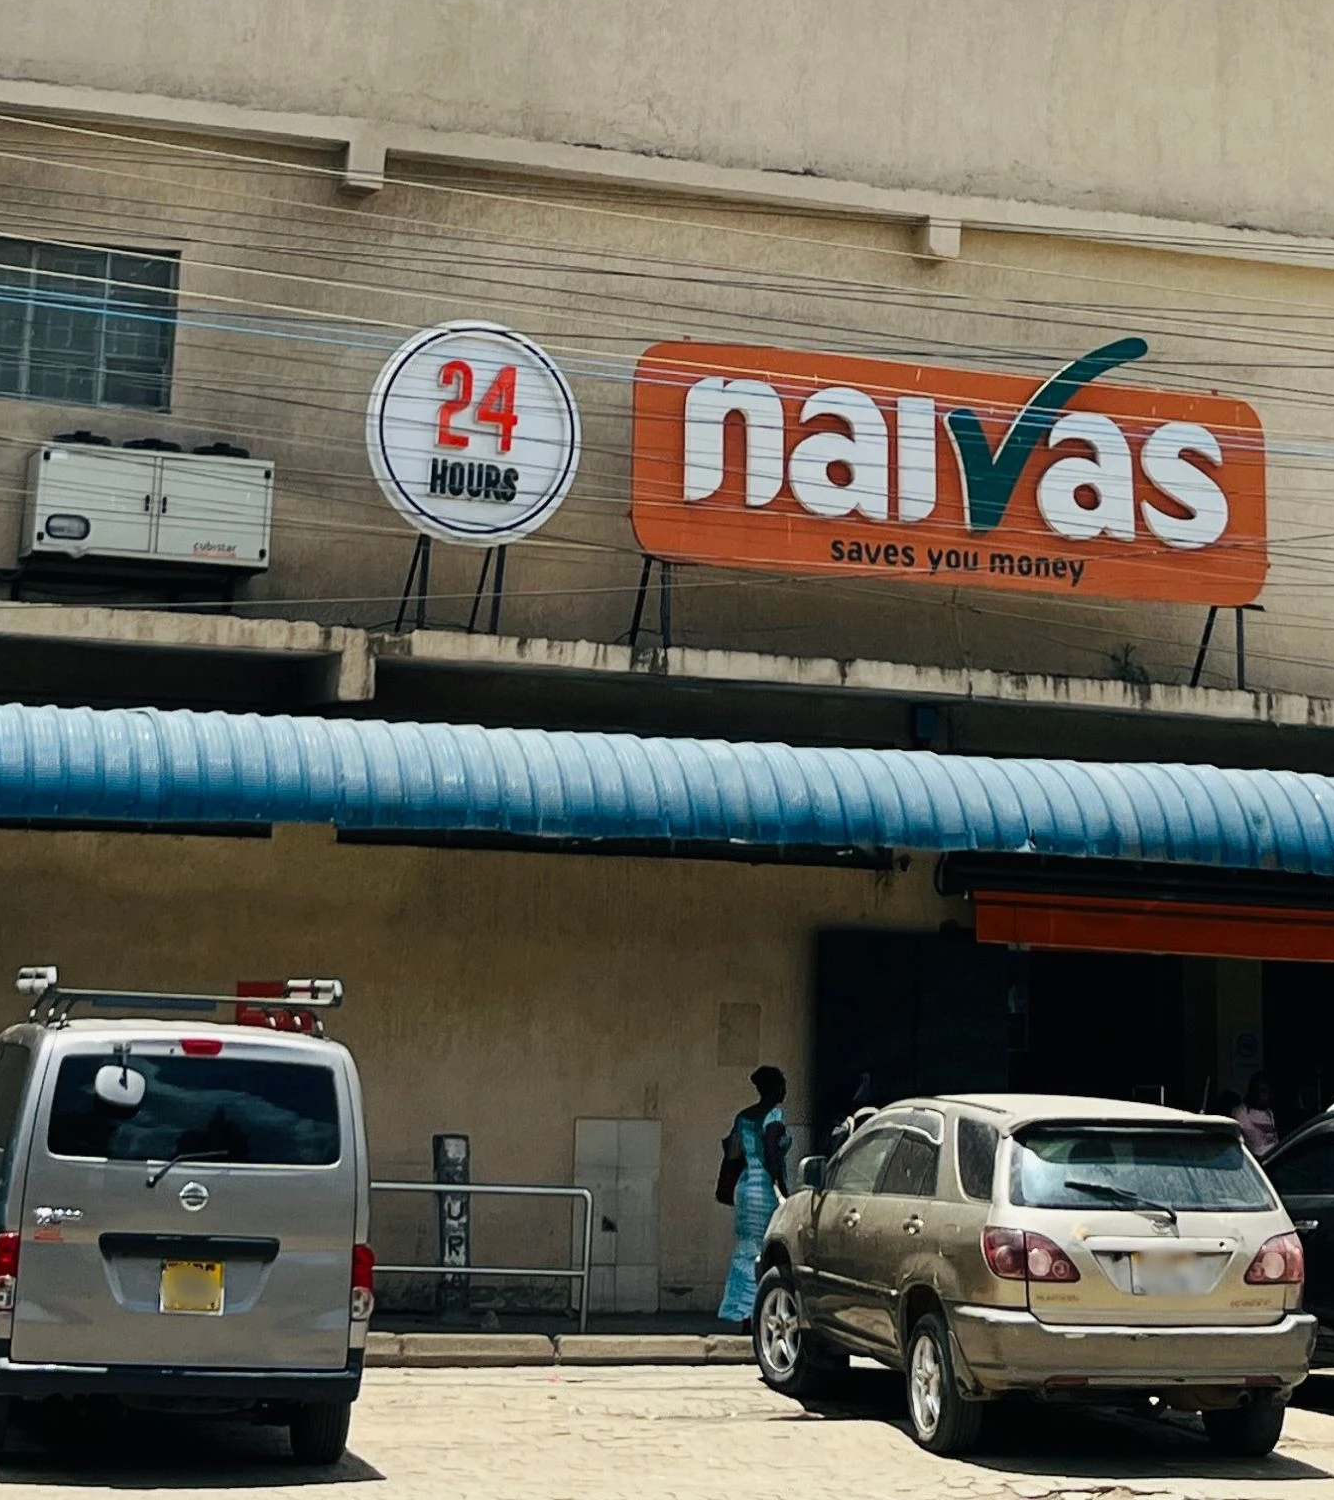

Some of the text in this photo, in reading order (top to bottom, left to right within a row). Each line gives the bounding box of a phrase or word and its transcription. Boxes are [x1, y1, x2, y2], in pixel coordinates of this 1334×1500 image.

[437, 359, 519, 455] 24
[682, 337, 1230, 550] naivas
[429, 457, 520, 503] HOURS
[831, 539, 1084, 587] saves you money
